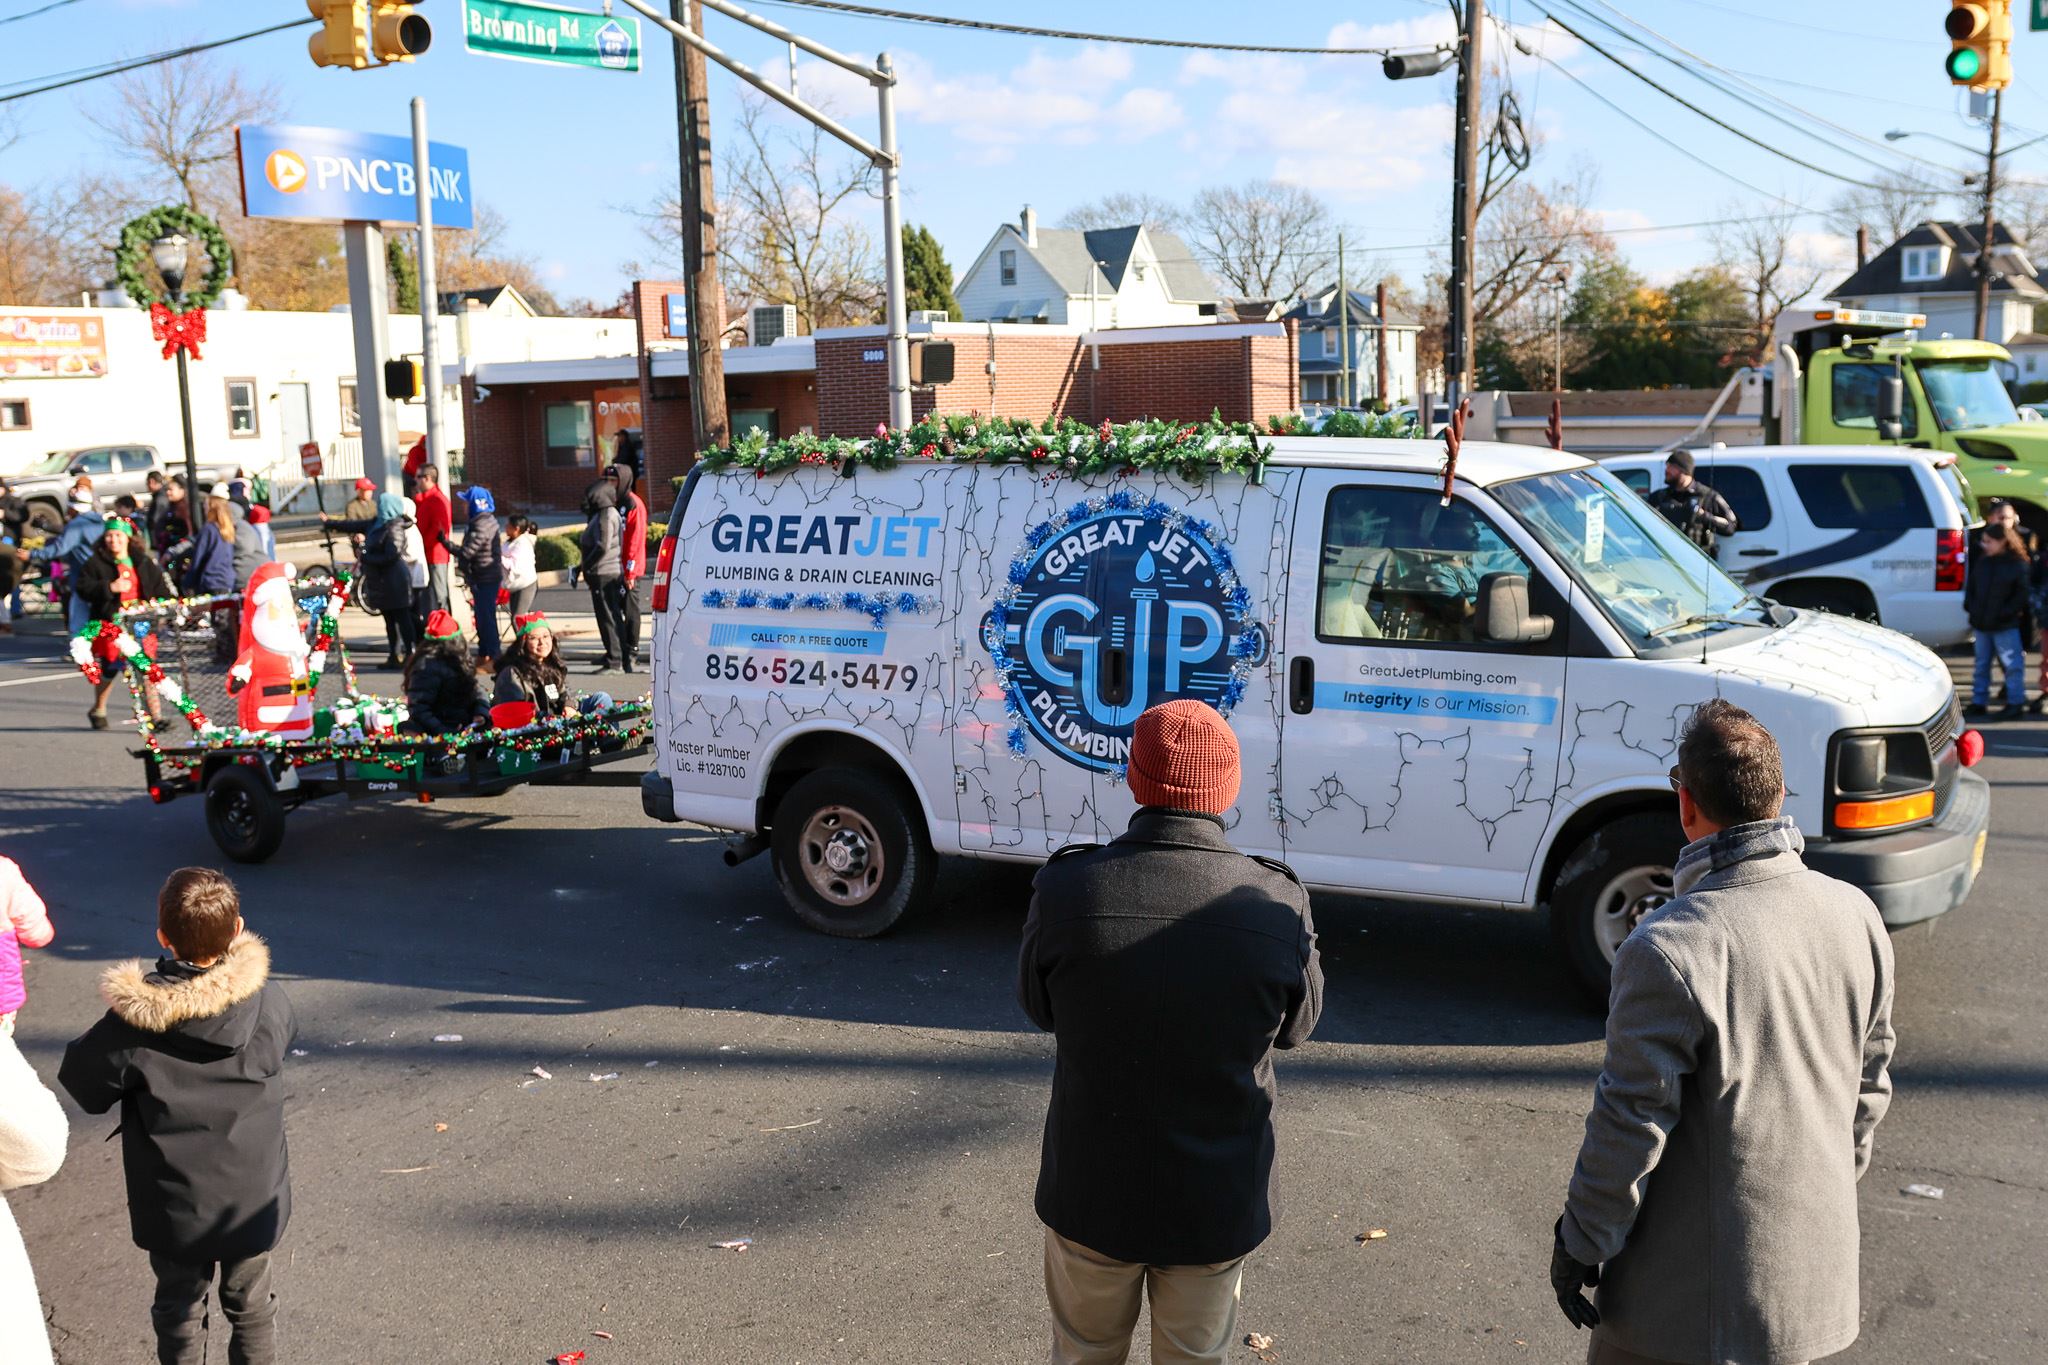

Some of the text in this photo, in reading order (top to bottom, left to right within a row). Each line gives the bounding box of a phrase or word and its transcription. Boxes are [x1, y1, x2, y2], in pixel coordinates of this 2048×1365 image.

[470, 9, 580, 54] Browning Rd
[1044, 518, 1208, 576] GREAT JET
[705, 566, 934, 587] PLUMBING & DRAIN CLEANING
[751, 633, 868, 648] CALL FOR A FREE QUOTE
[1359, 664, 1517, 685] GreatJetPlumbing.com
[1343, 690, 1530, 715] Integrity Is Our Mission.
[1031, 690, 1132, 760] PLUMBIN
[669, 739, 751, 760] Master Plumber
[676, 758, 746, 779] Lic. #1287100
[368, 782, 398, 791] Carry-On
